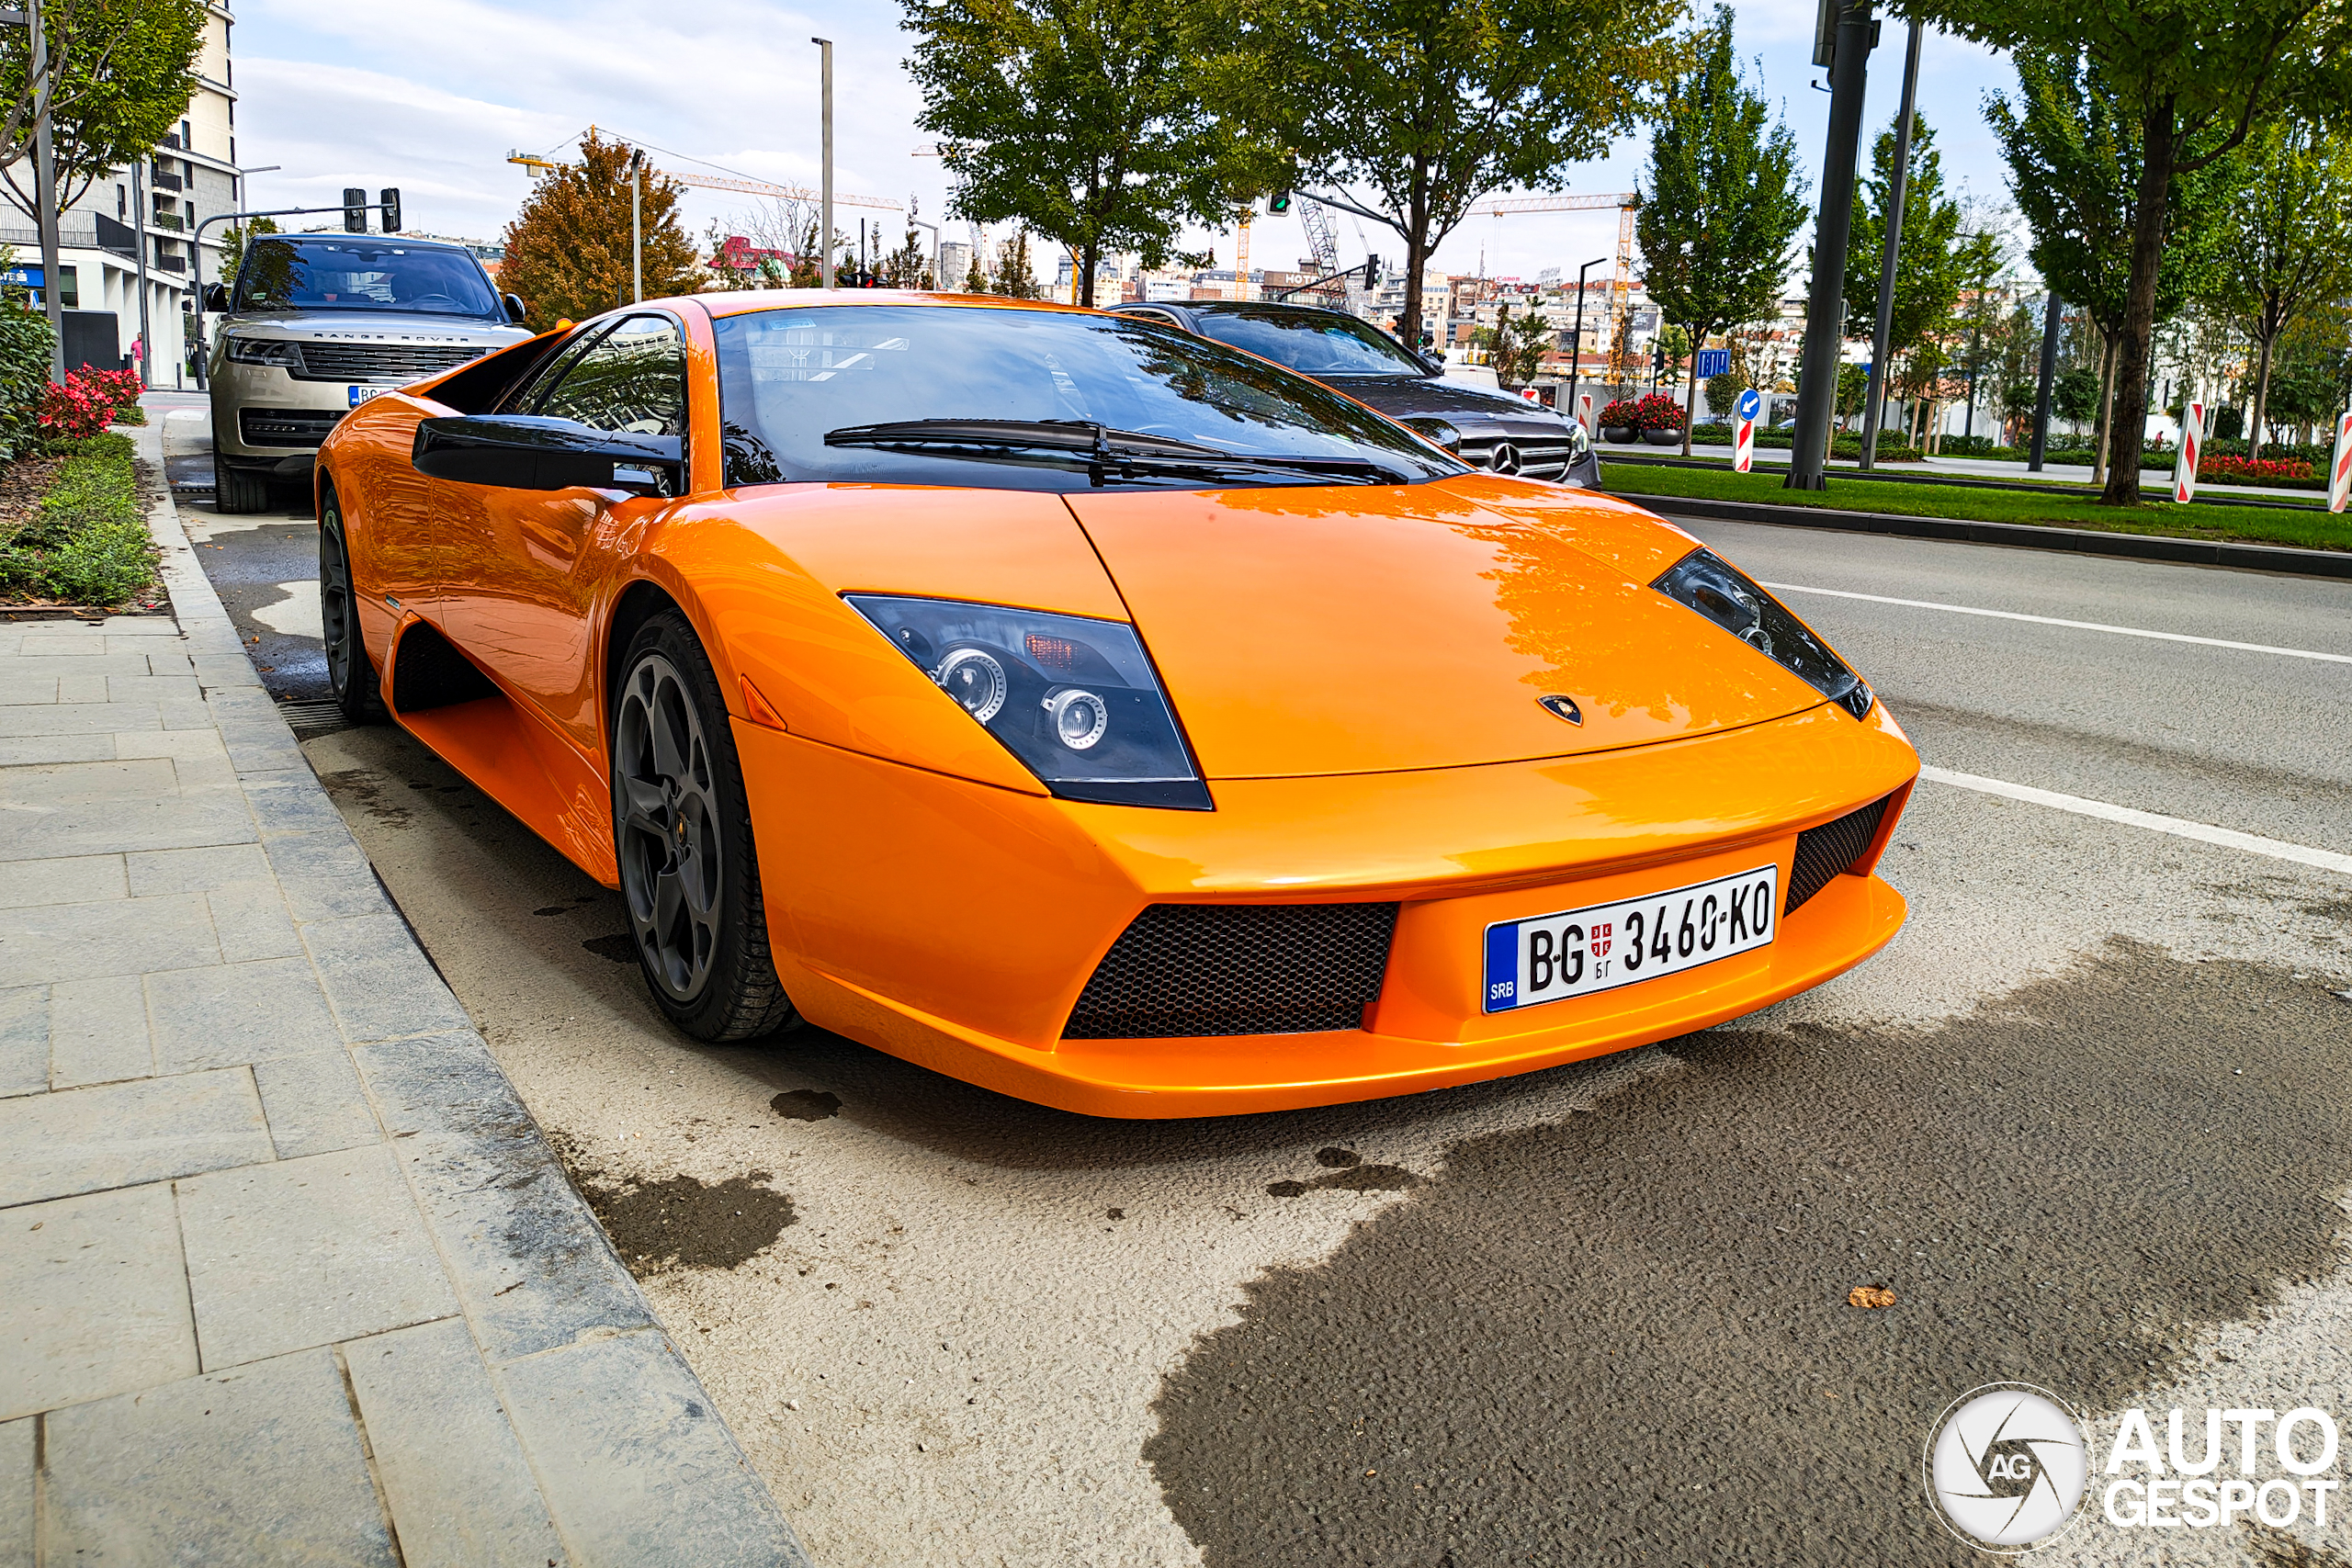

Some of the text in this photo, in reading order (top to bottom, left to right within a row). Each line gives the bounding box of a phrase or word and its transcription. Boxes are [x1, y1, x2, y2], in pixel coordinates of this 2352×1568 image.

[1286, 274, 1325, 286] HOTE
[1530, 924, 1585, 993] BG
[1595, 960, 1611, 979] БГ
[1490, 980, 1514, 1000] SRB
